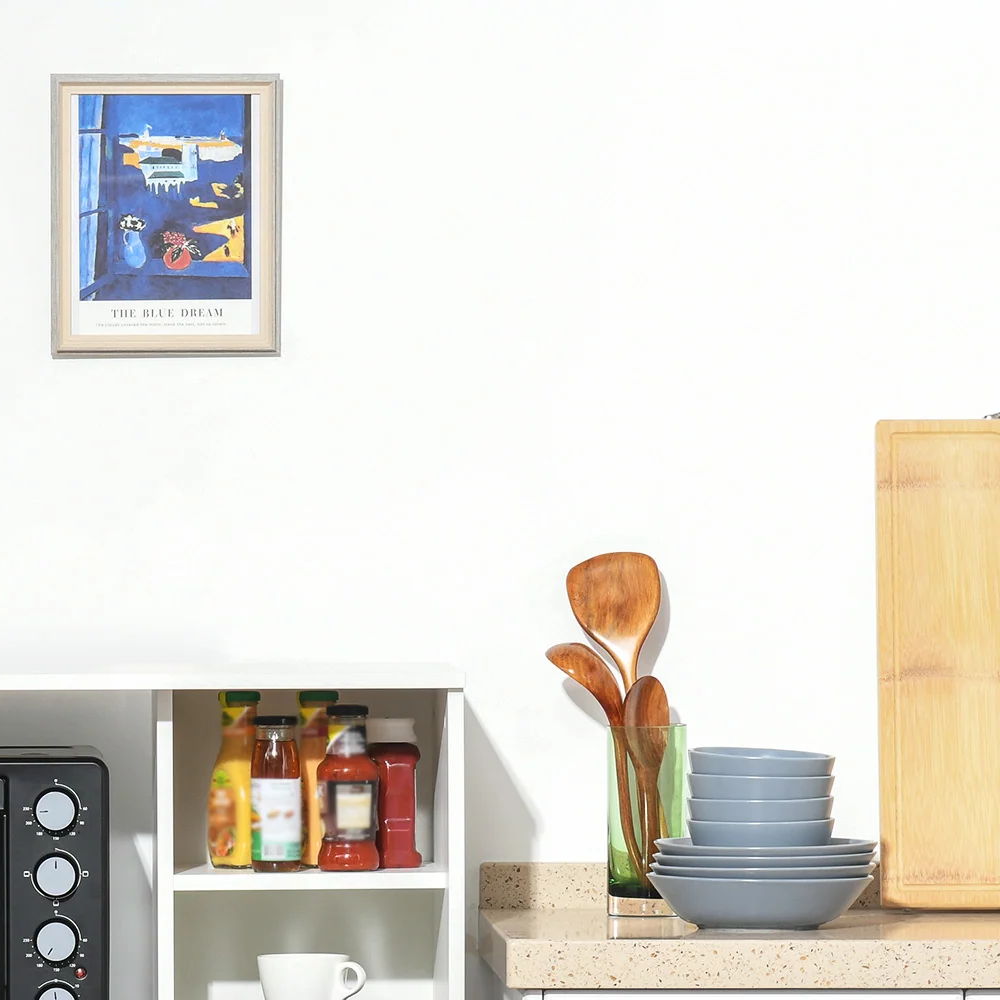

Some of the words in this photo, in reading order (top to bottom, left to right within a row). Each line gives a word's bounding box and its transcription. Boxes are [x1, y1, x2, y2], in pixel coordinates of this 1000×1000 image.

[110, 309, 136, 318] THE
[143, 308, 175, 318] BLUE
[181, 308, 224, 317] DREAM
